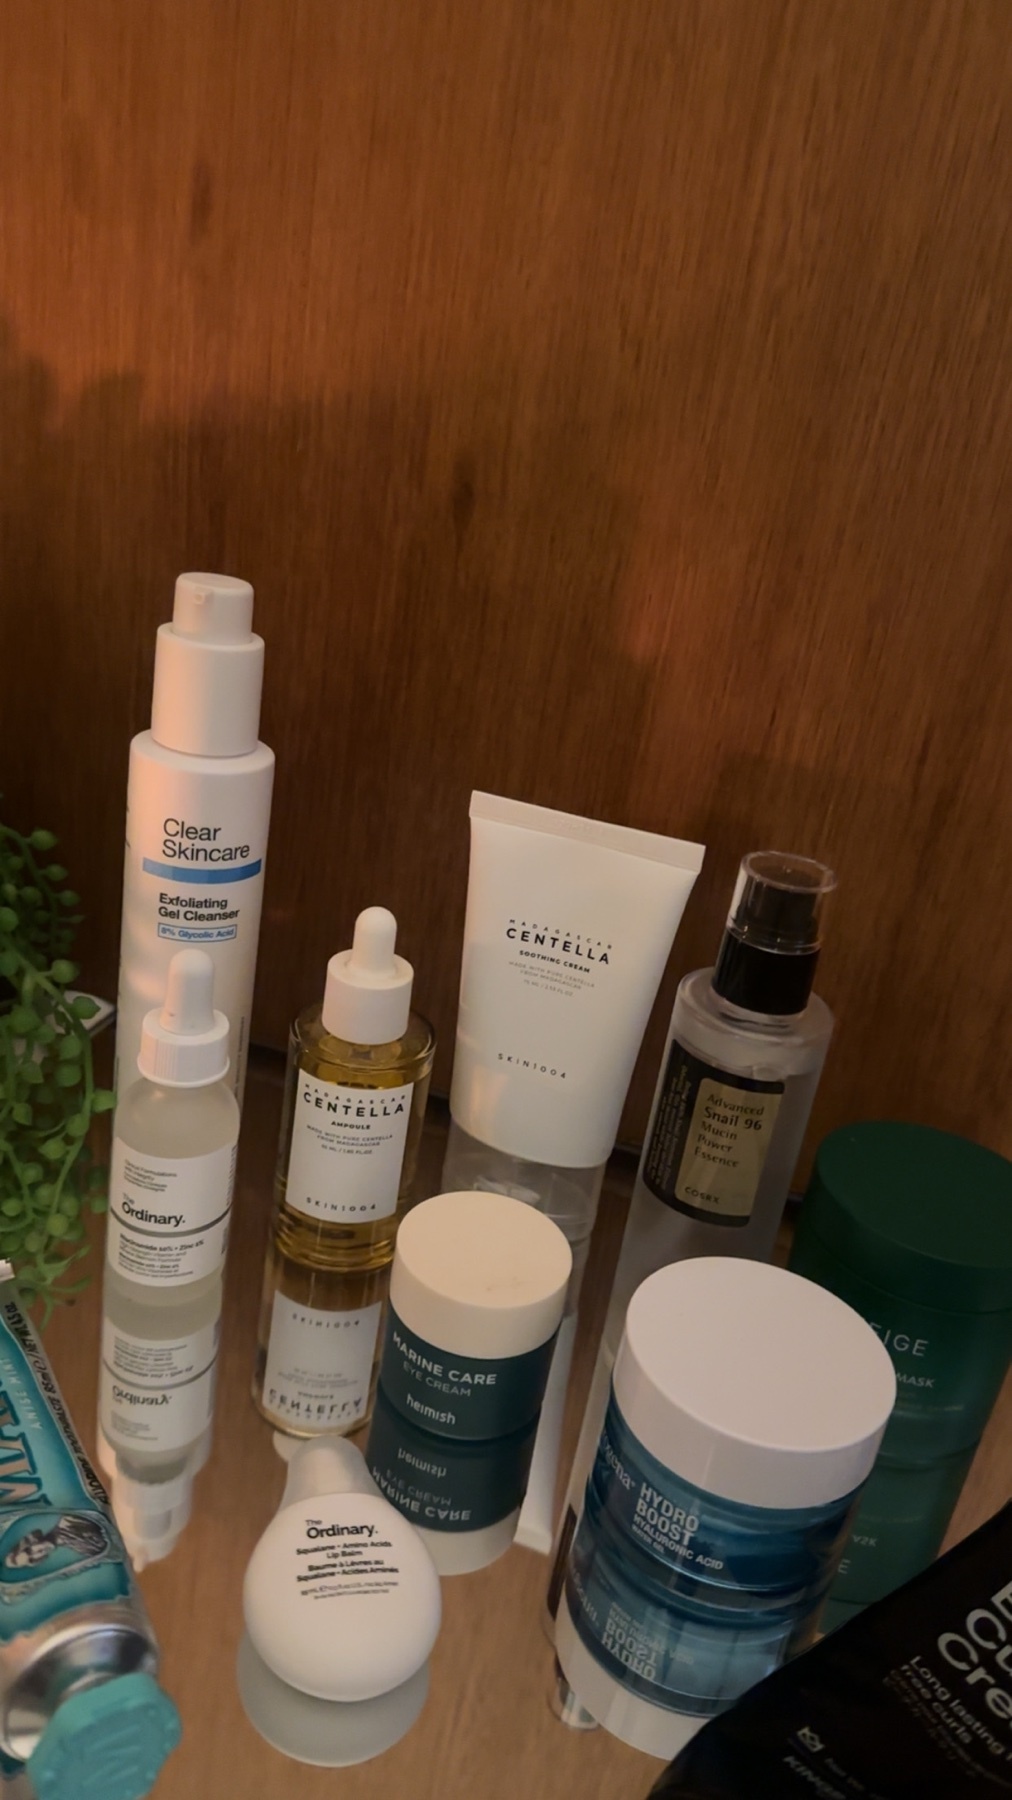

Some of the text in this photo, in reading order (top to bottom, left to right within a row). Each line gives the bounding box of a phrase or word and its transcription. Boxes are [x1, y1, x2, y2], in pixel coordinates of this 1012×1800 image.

[163, 817, 222, 841] Clear
[162, 839, 251, 862] Skincare
[158, 906, 241, 922] Gel Cleanser
[159, 892, 229, 910] Exfoliating
[160, 926, 236, 939] 8% Glycolic Acid
[506, 927, 610, 965] CENTELLA
[519, 949, 591, 974] SOOTHING CREAM
[497, 1052, 567, 1080] SKIN1004
[303, 1091, 405, 1118] CENTELLA
[706, 1093, 766, 1117] Advanced
[330, 1120, 372, 1131] AMPOULE
[700, 1120, 739, 1141] Mucin
[703, 1105, 763, 1132] Snail 96
[697, 1133, 734, 1153] Power
[693, 1145, 740, 1169] Essence
[121, 1201, 187, 1228] Ordinary.
[392, 1330, 444, 1378] MARINE
[448, 1369, 498, 1386] CARE
[403, 1361, 472, 1397] EYE CREAM
[406, 1392, 457, 1426] heimish
[640, 1481, 700, 1533] HYDRO
[306, 1524, 380, 1540] Ordinary.
[635, 1497, 695, 1546] BOOST
[633, 1514, 725, 1571] HYALURONIC ACID
[909, 1655, 951, 1701] Long
[949, 1699, 1005, 1755] lasting
[931, 1702, 973, 1744] curls
